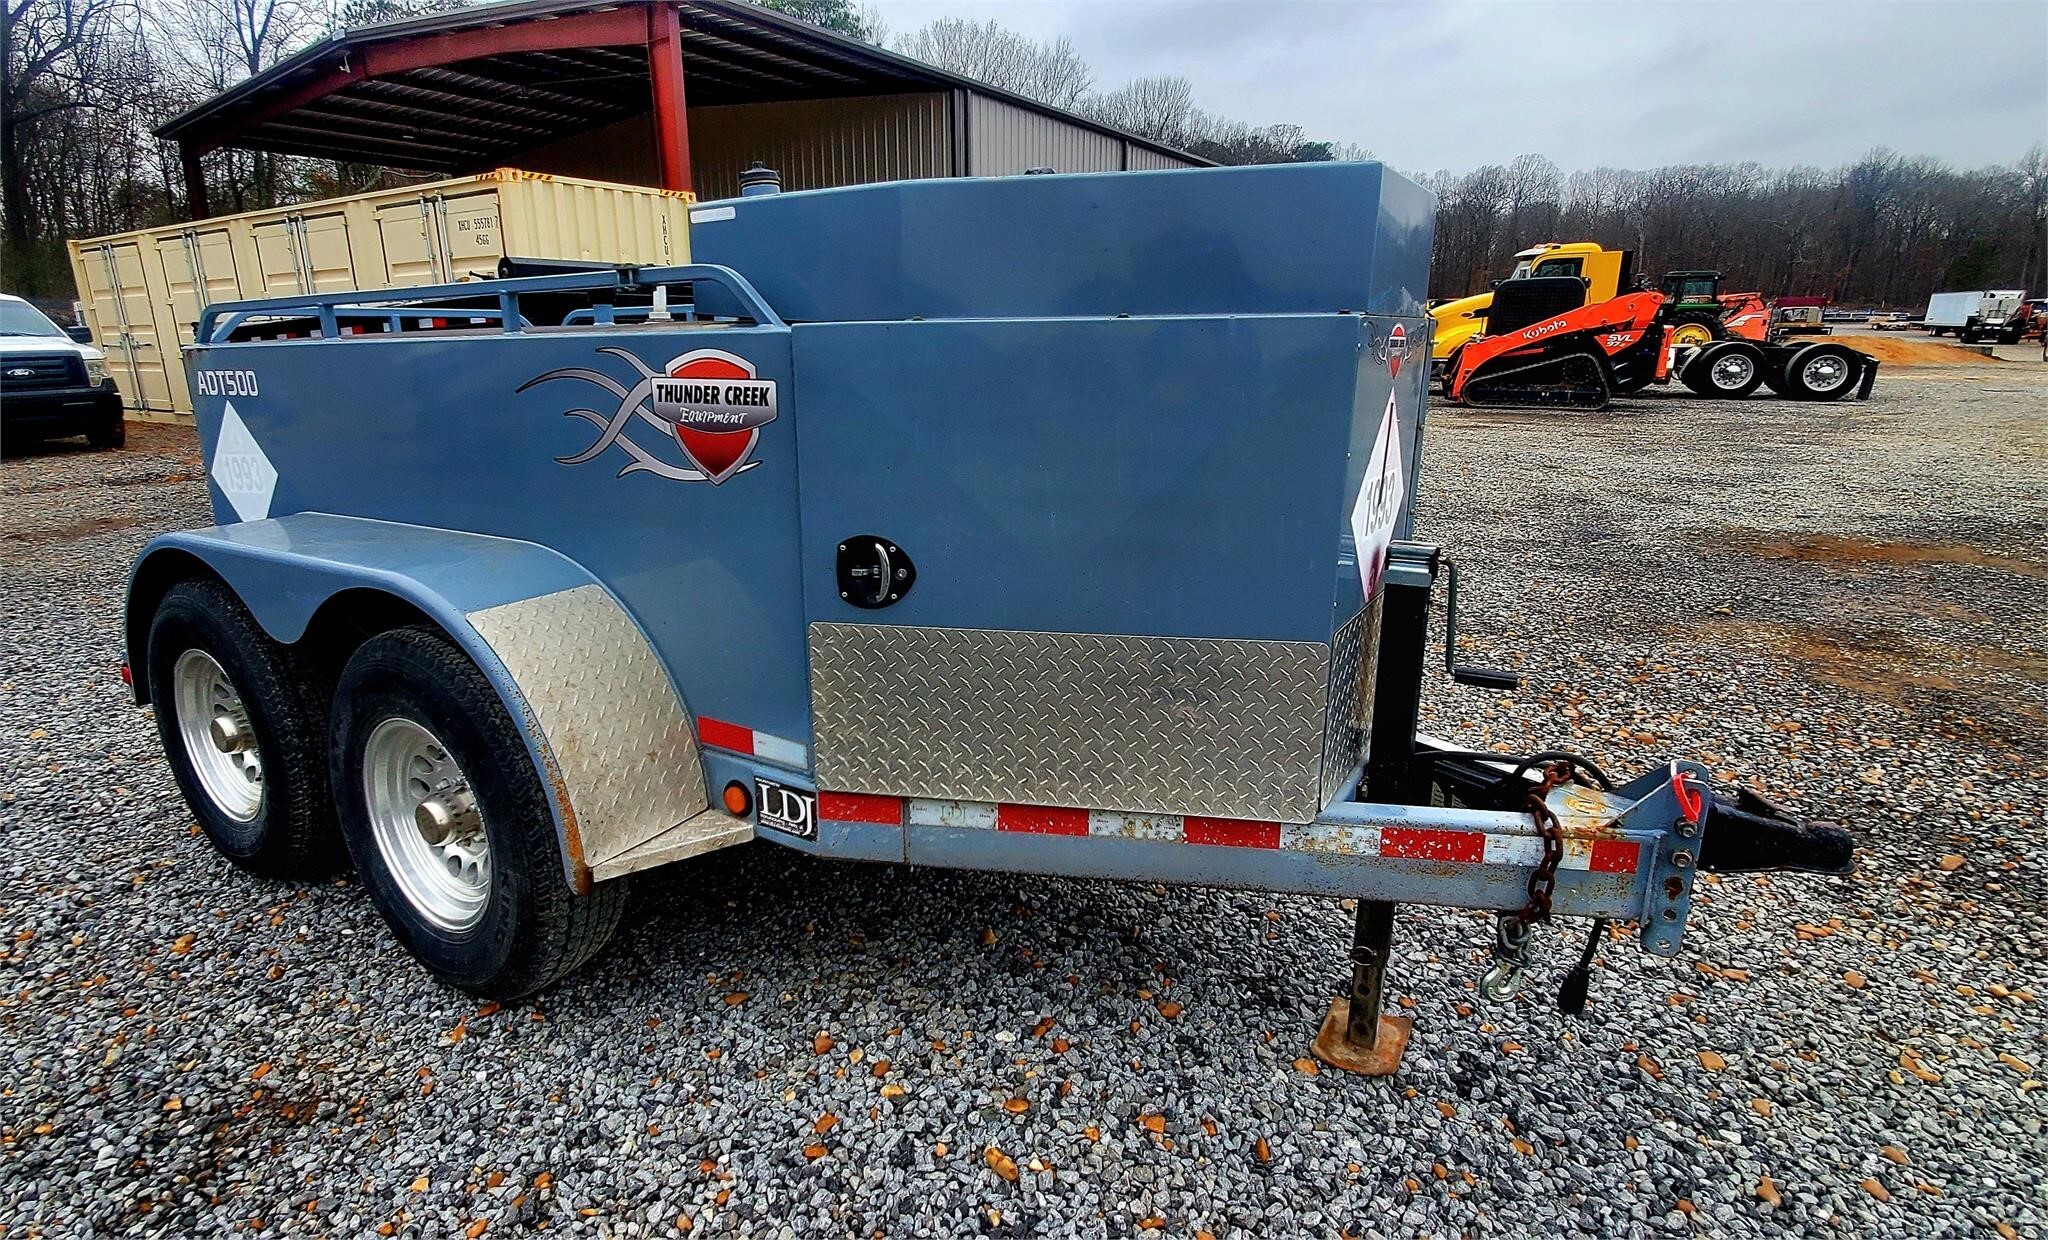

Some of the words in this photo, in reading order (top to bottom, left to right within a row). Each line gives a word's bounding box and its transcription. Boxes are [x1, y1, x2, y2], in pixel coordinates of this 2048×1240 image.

[661, 214, 670, 256] XHCU
[1523, 320, 1567, 339] Kubota
[1608, 334, 1634, 342] SVL
[197, 370, 259, 397] ADT500
[656, 384, 721, 406] THUNDER
[724, 386, 770, 407] CREEK
[224, 456, 263, 492] 1993
[1365, 472, 1395, 537] 1993
[757, 783, 815, 836] LDJ
